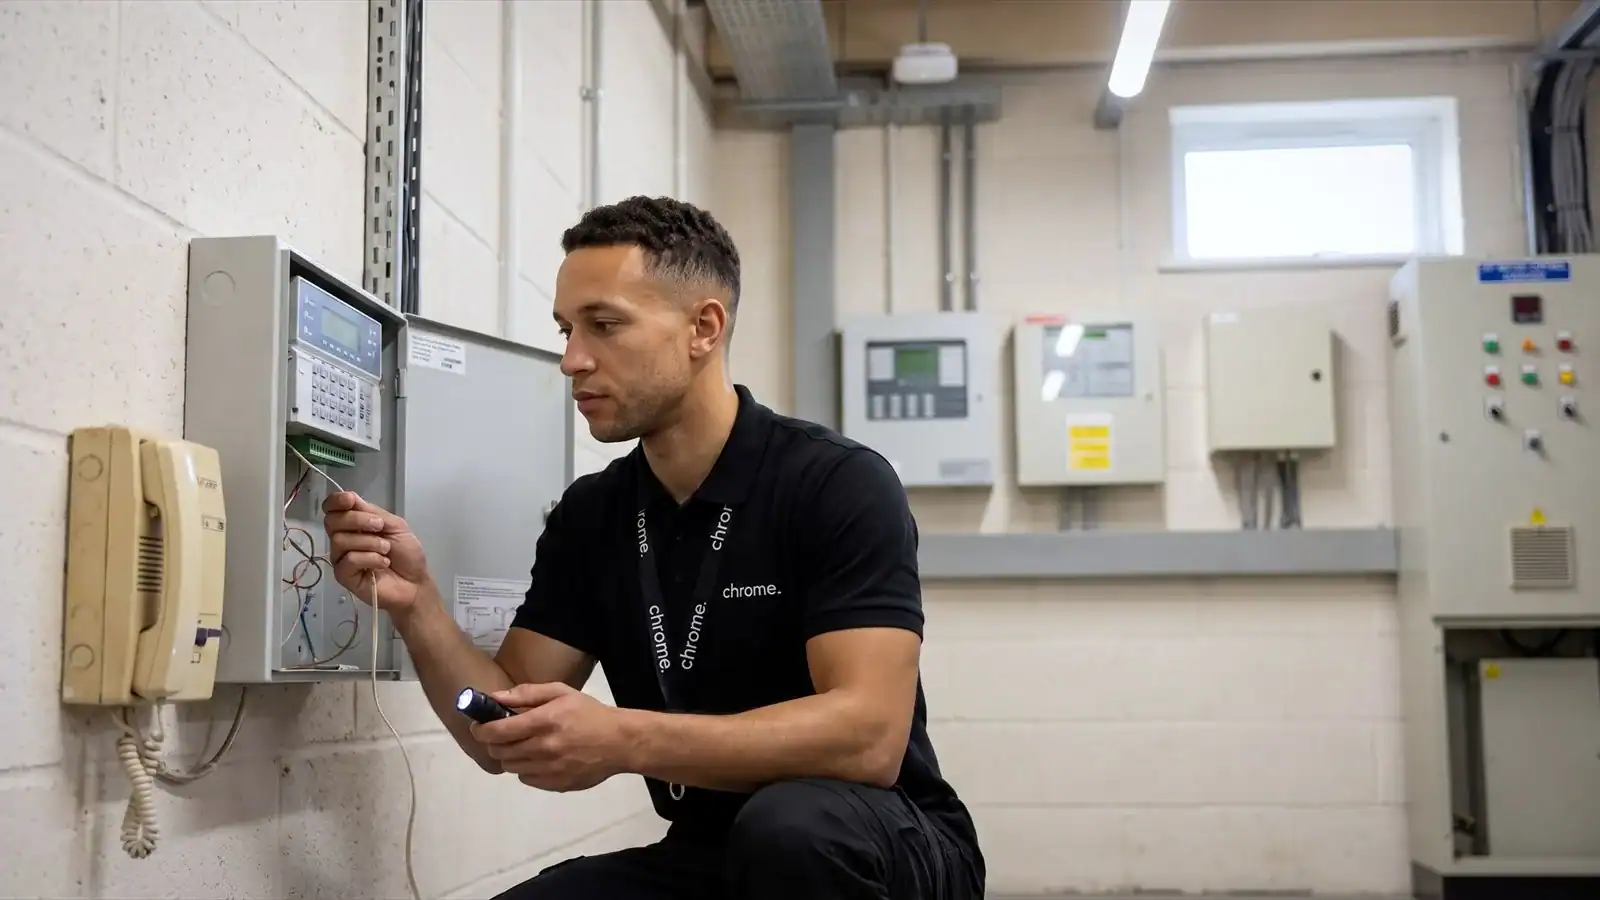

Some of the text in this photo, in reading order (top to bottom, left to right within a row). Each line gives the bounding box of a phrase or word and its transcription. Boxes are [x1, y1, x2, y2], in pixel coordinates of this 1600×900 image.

[722, 583, 782, 599] chrome.
[649, 604, 671, 674] chrome.
[680, 601, 707, 670] chrome.
